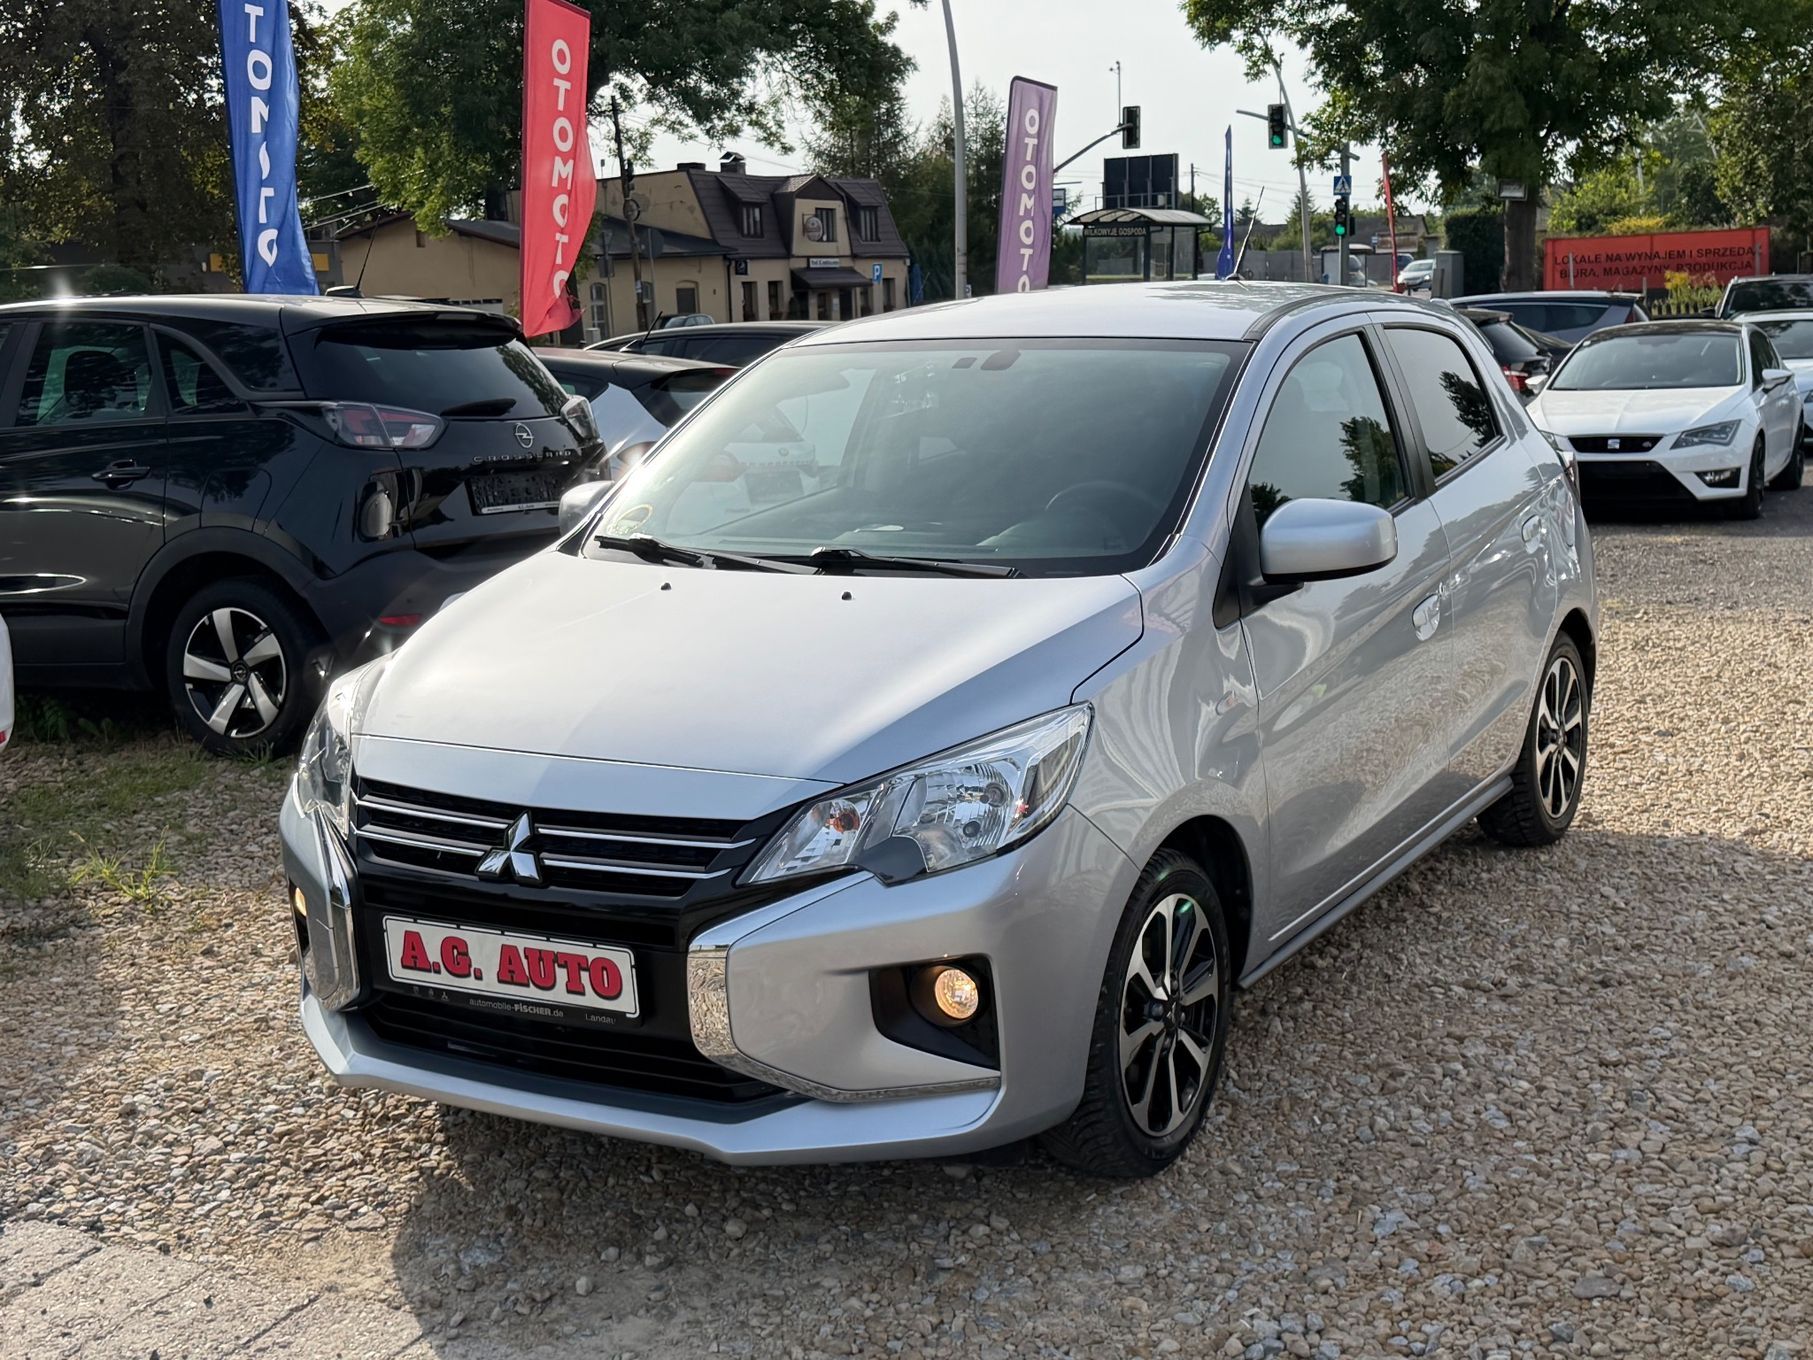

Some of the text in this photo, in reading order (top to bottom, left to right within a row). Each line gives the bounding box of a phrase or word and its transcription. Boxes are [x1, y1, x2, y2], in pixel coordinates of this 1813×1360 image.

[551, 38, 574, 299] OTOMOTO
[1018, 108, 1039, 293] OTOMOTO
[1119, 226, 1146, 236] GOSPODA
[1554, 254, 1602, 265] LOKALE
[1605, 252, 1622, 263] NA
[1625, 249, 1686, 262] WYNAJEM
[1560, 268, 1599, 279] BURA,
[401, 930, 624, 1001] A.G. AUTO
